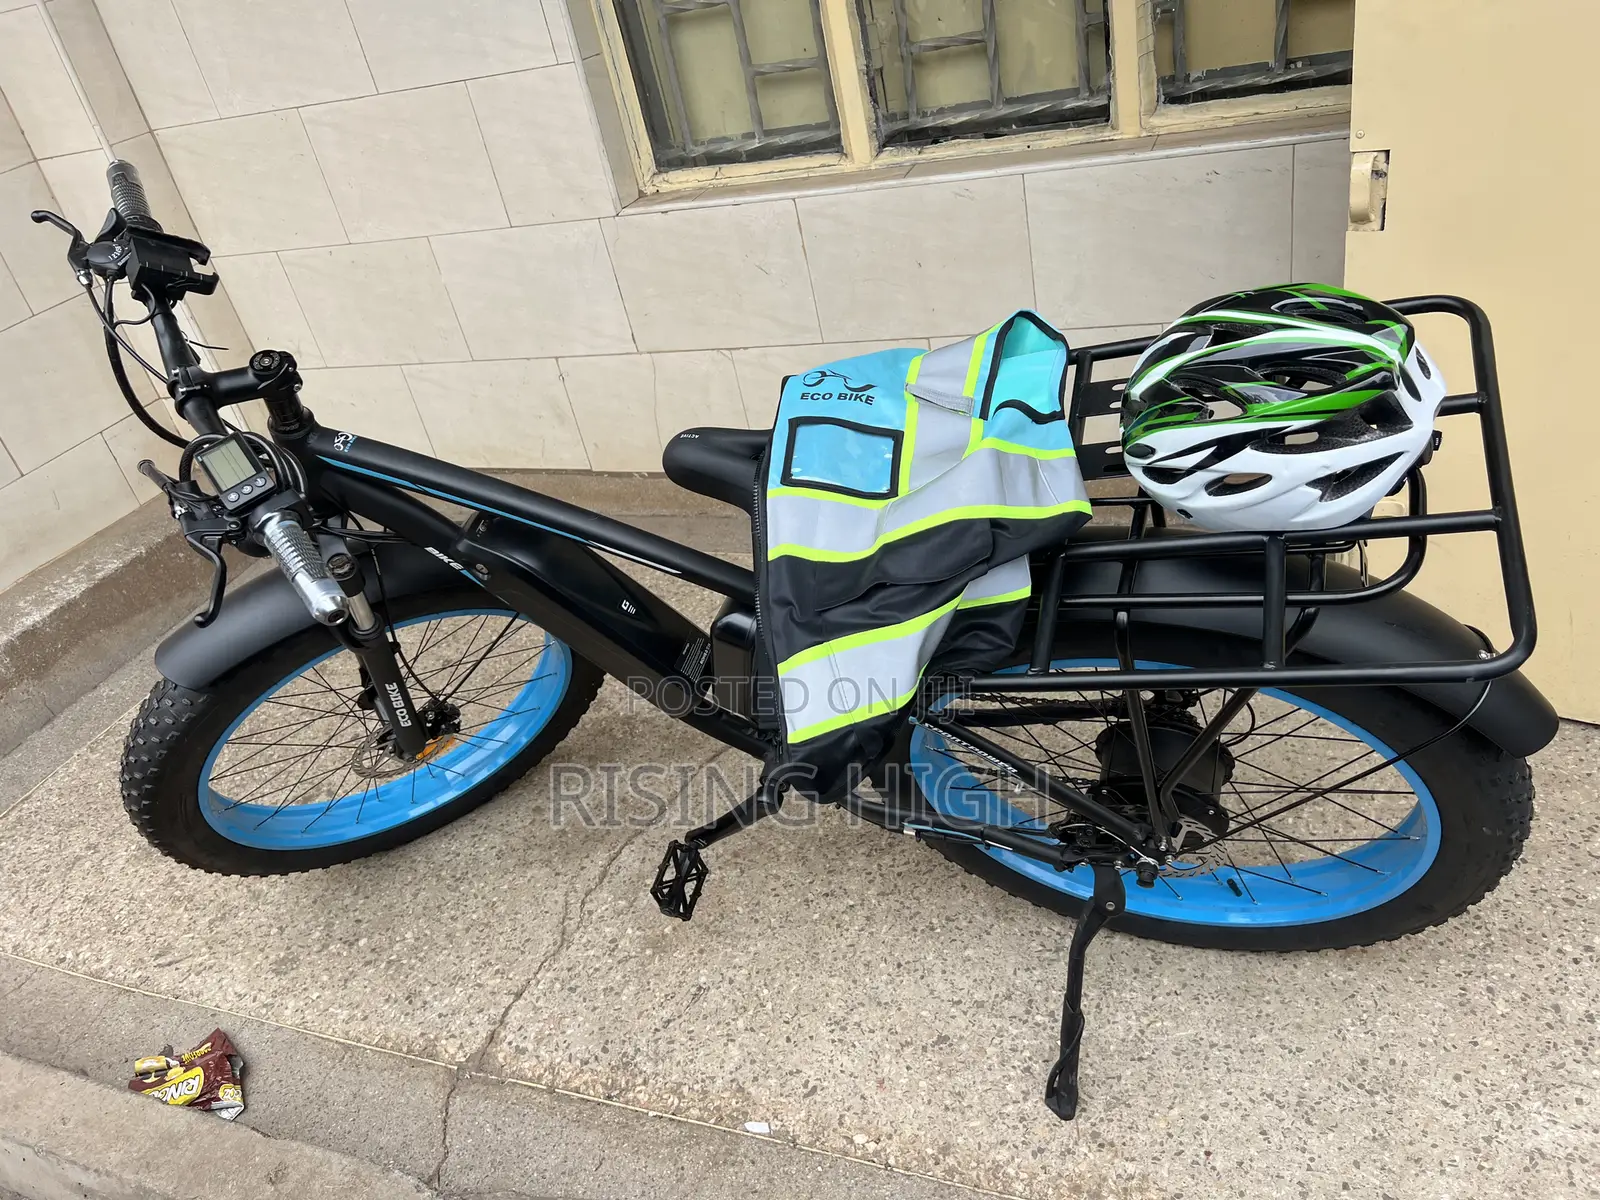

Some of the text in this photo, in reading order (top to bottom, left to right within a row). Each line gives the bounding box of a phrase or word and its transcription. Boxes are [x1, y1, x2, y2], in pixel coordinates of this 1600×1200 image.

[800, 392, 875, 405] ECO BIKE
[424, 546, 464, 571] BIKE
[384, 681, 412, 728] ECO BIKE
[924, 722, 1018, 773] SPORTPOWER
